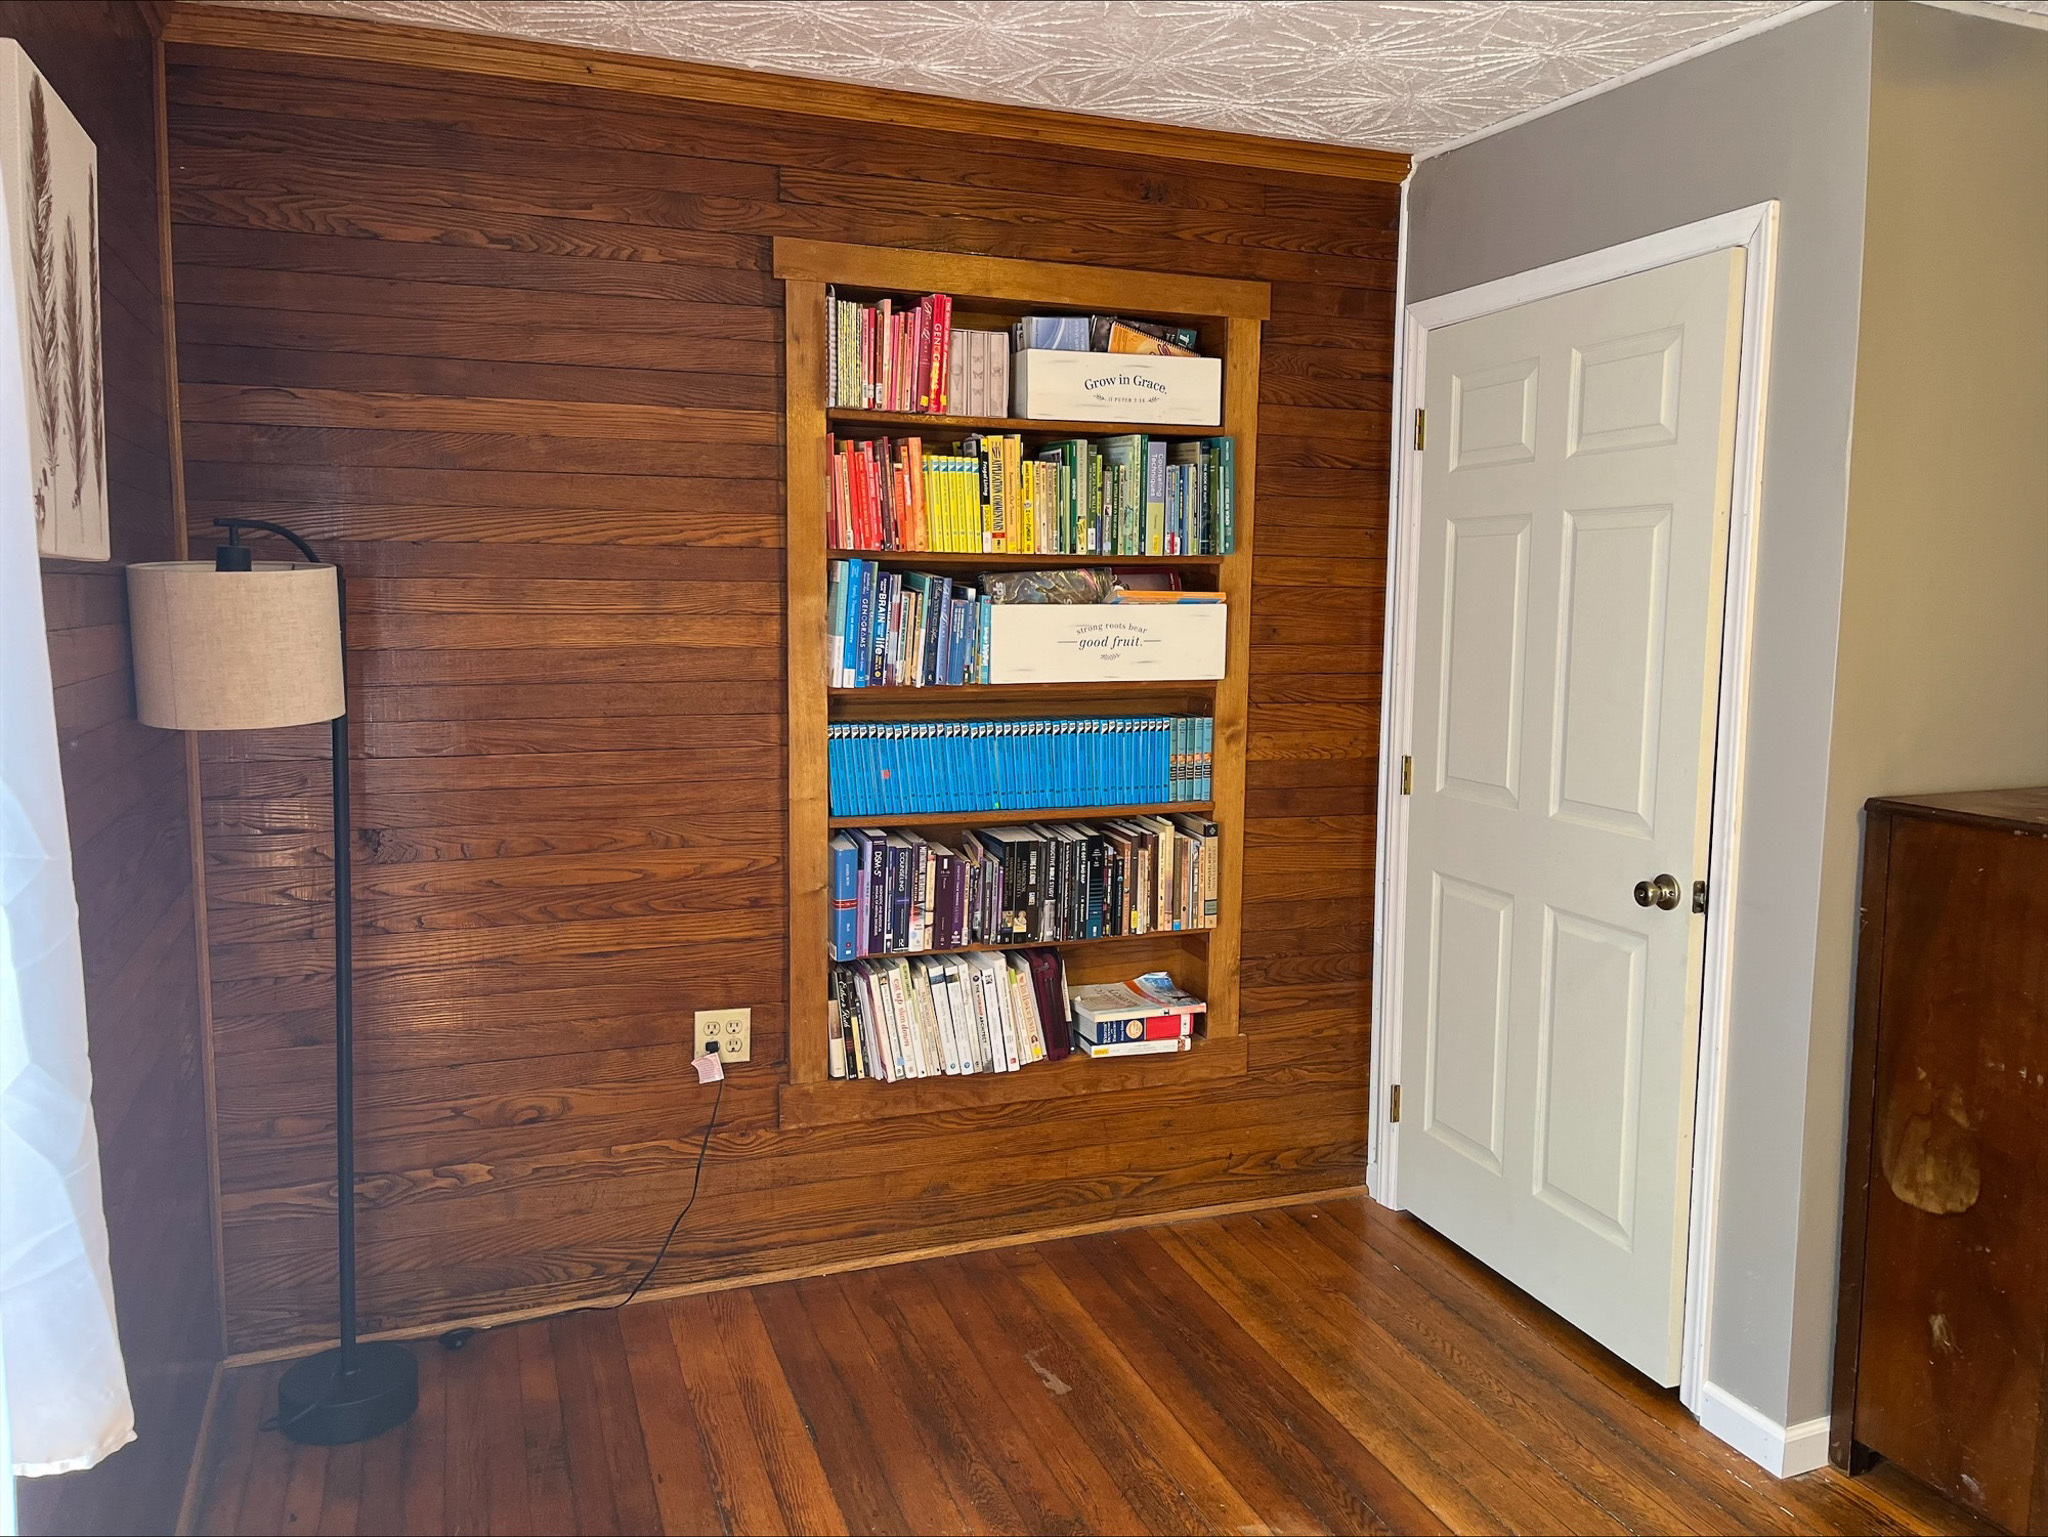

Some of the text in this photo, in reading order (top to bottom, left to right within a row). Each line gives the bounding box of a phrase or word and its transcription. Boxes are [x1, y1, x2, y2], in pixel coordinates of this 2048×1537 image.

[1084, 374, 1167, 395] Grow in Grace.
[992, 460, 1004, 531] APPLICATION COMMENTARY
[878, 593, 886, 622] BRAIN
[860, 598, 868, 648] GENOGRAMS
[1076, 622, 1148, 635] strong roots bear
[875, 638, 884, 655] life
[1078, 635, 1144, 650] good fruit.
[874, 851, 882, 877] DSM-5
[842, 1009, 850, 1028] Ruth
[894, 993, 903, 1005] up
[900, 1024, 909, 1047] down
[979, 1017, 987, 1043] ARCHITECT
